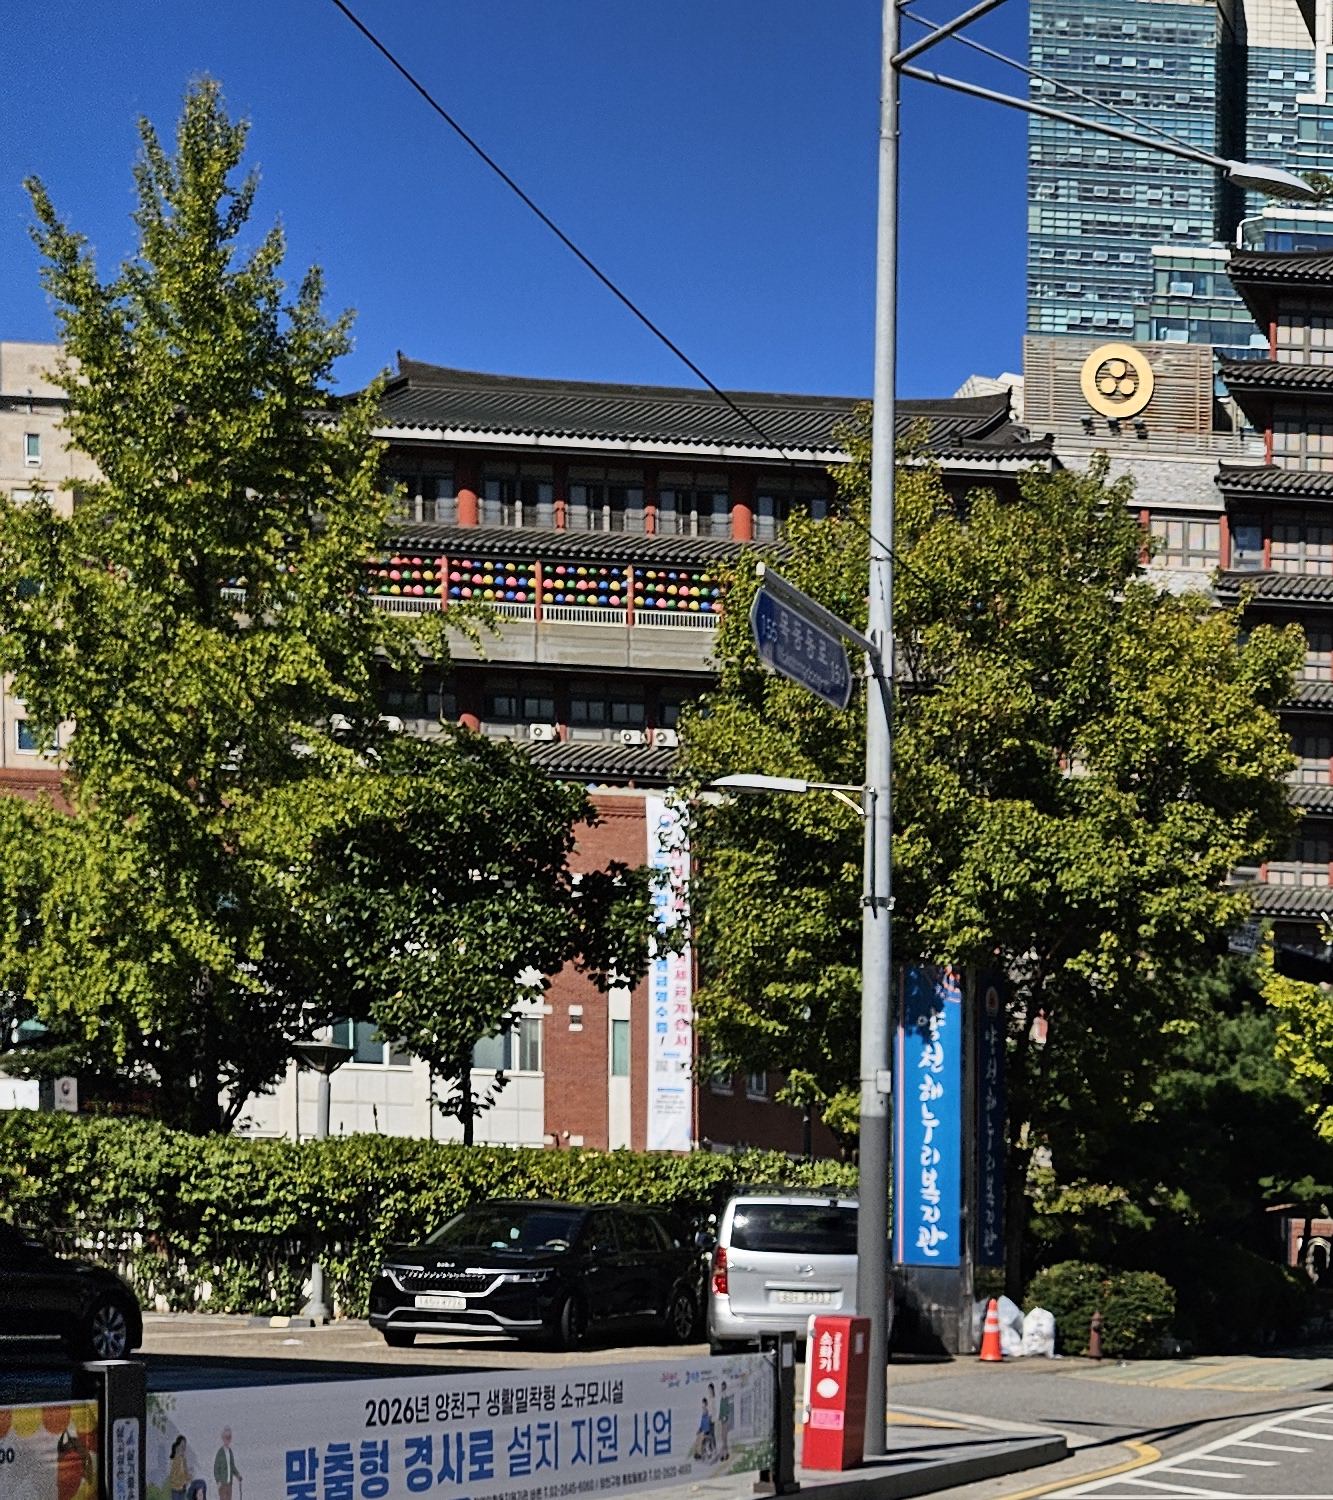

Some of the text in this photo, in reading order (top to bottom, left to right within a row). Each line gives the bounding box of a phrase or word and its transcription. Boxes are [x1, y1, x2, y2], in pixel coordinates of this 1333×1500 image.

[915, 1007, 949, 1258] 양천해누리복지관
[818, 1331, 834, 1373] 소화기
[364, 1396, 431, 1428] 2026년
[434, 1391, 481, 1421] 양천구
[485, 1384, 557, 1416] 생활밀착형
[560, 1379, 625, 1408] 소규모시설
[404, 1429, 495, 1493] 경사로
[506, 1421, 560, 1478] 설치
[571, 1413, 619, 1471] 지원
[628, 1408, 673, 1458] 사업
